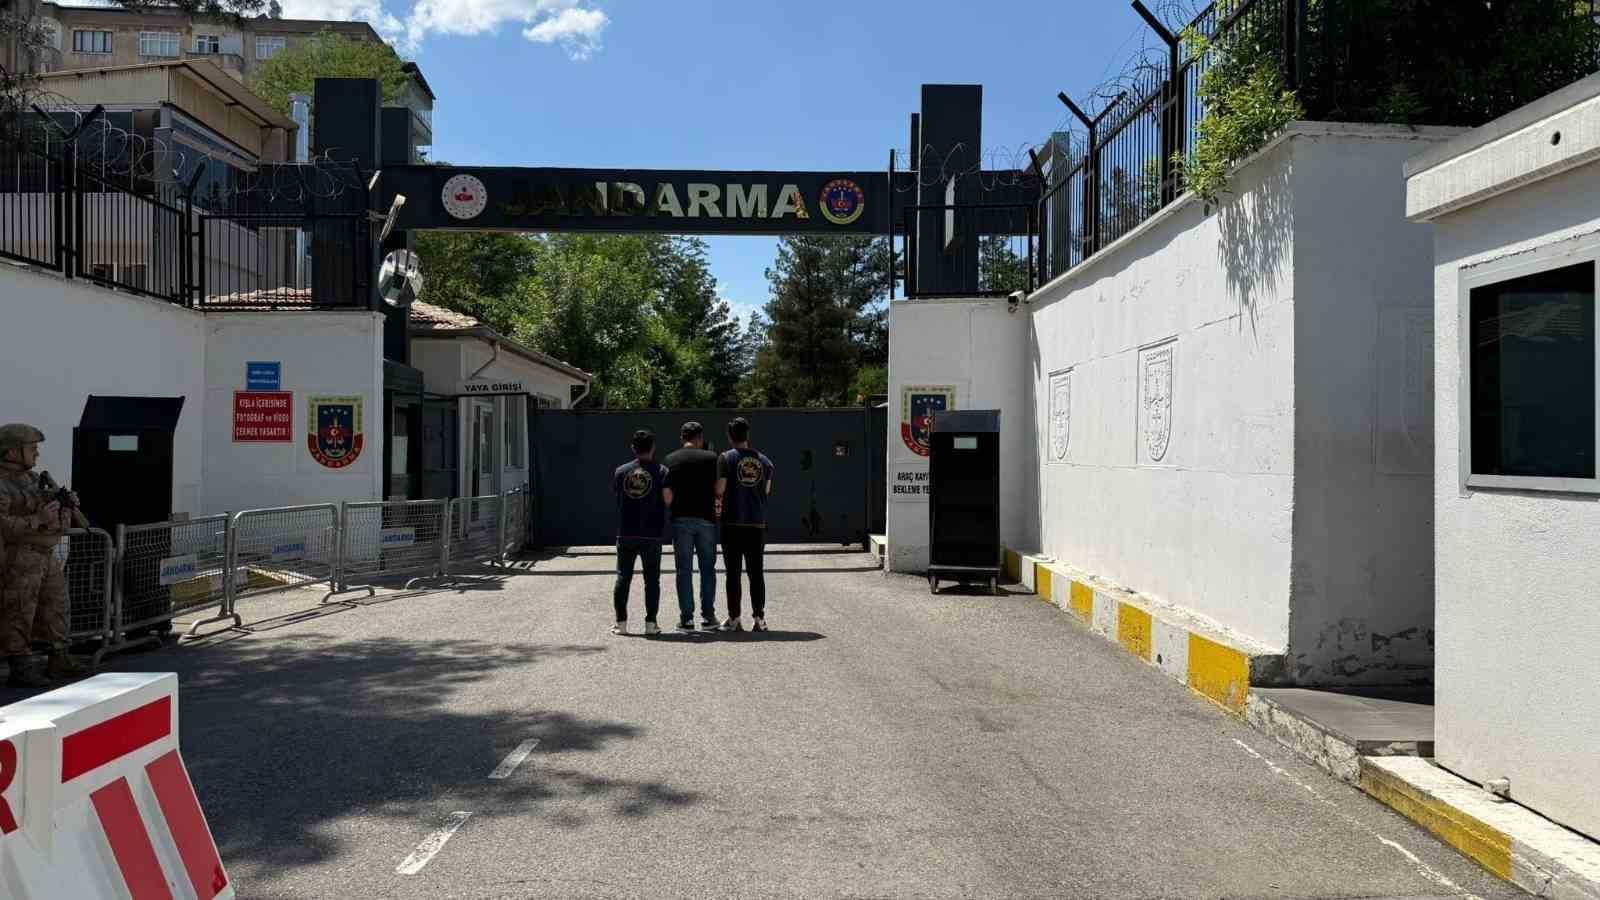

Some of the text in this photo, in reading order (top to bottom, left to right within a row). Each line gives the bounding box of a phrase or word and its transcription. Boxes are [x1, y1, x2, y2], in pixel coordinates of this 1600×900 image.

[464, 384, 489, 392] YAYA
[893, 485, 930, 494] BEKLEME YE
